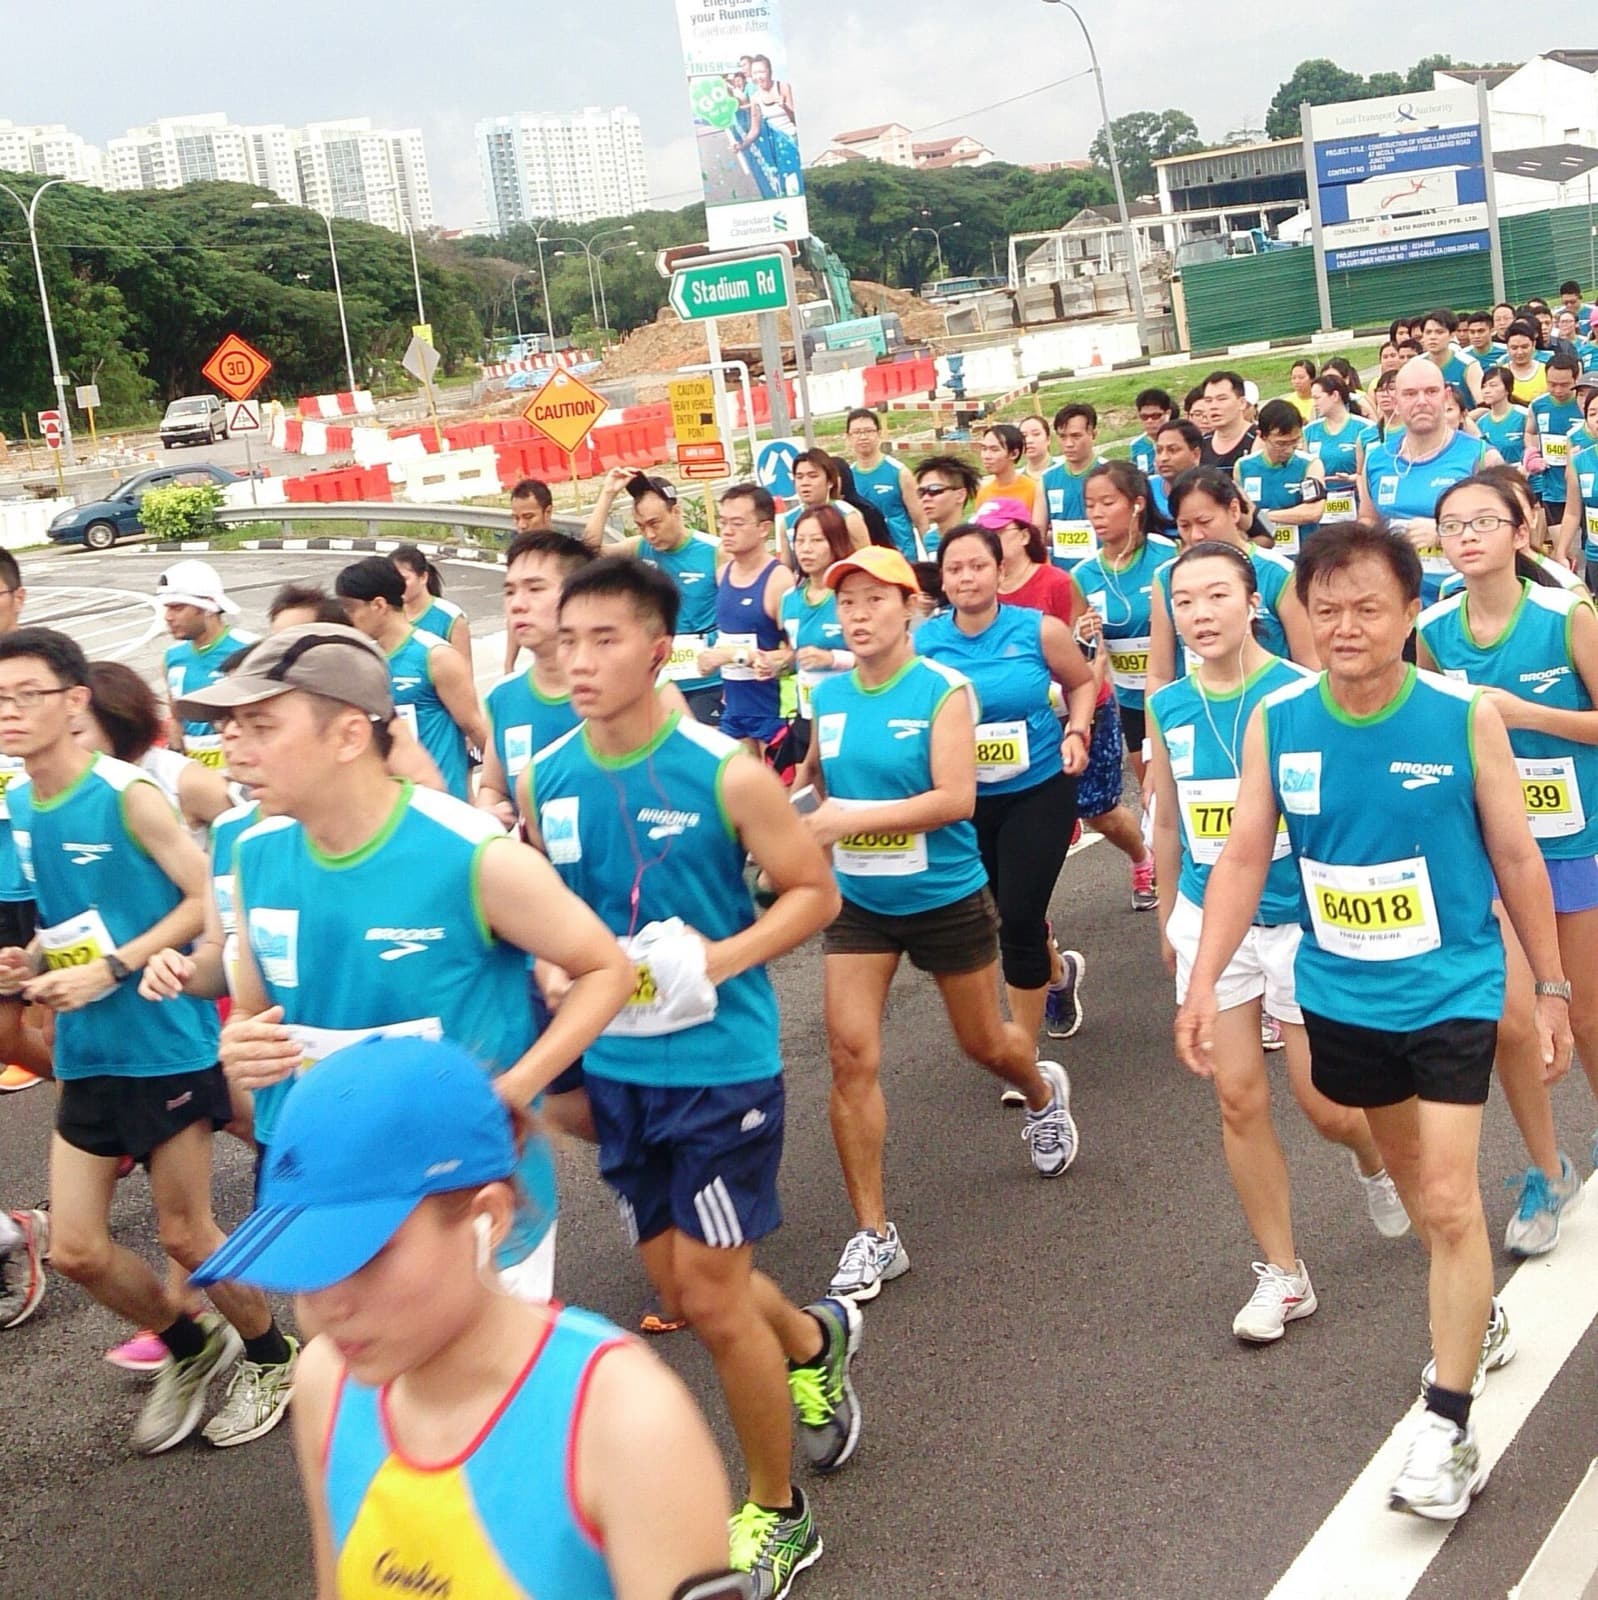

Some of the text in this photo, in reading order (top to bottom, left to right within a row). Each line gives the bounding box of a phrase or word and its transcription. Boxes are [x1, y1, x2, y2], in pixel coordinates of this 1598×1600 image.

[690, 7, 771, 26] your Runners.
[744, 20, 769, 33] After
[687, 61, 724, 74] INISH
[691, 269, 776, 305] Stadium Rd
[226, 360, 245, 376] 30
[677, 383, 706, 396] CAUTION
[534, 399, 596, 422] CAUTION
[676, 413, 695, 425] ENTRY
[687, 427, 705, 438] POINT
[1057, 531, 1088, 545] 67322
[1519, 665, 1573, 682] BROOKS
[977, 742, 1014, 762] 820
[1389, 761, 1454, 776] BROOKS
[636, 807, 701, 828] BROOKS
[1323, 892, 1413, 926] 64018
[364, 927, 447, 942] BROOKS
